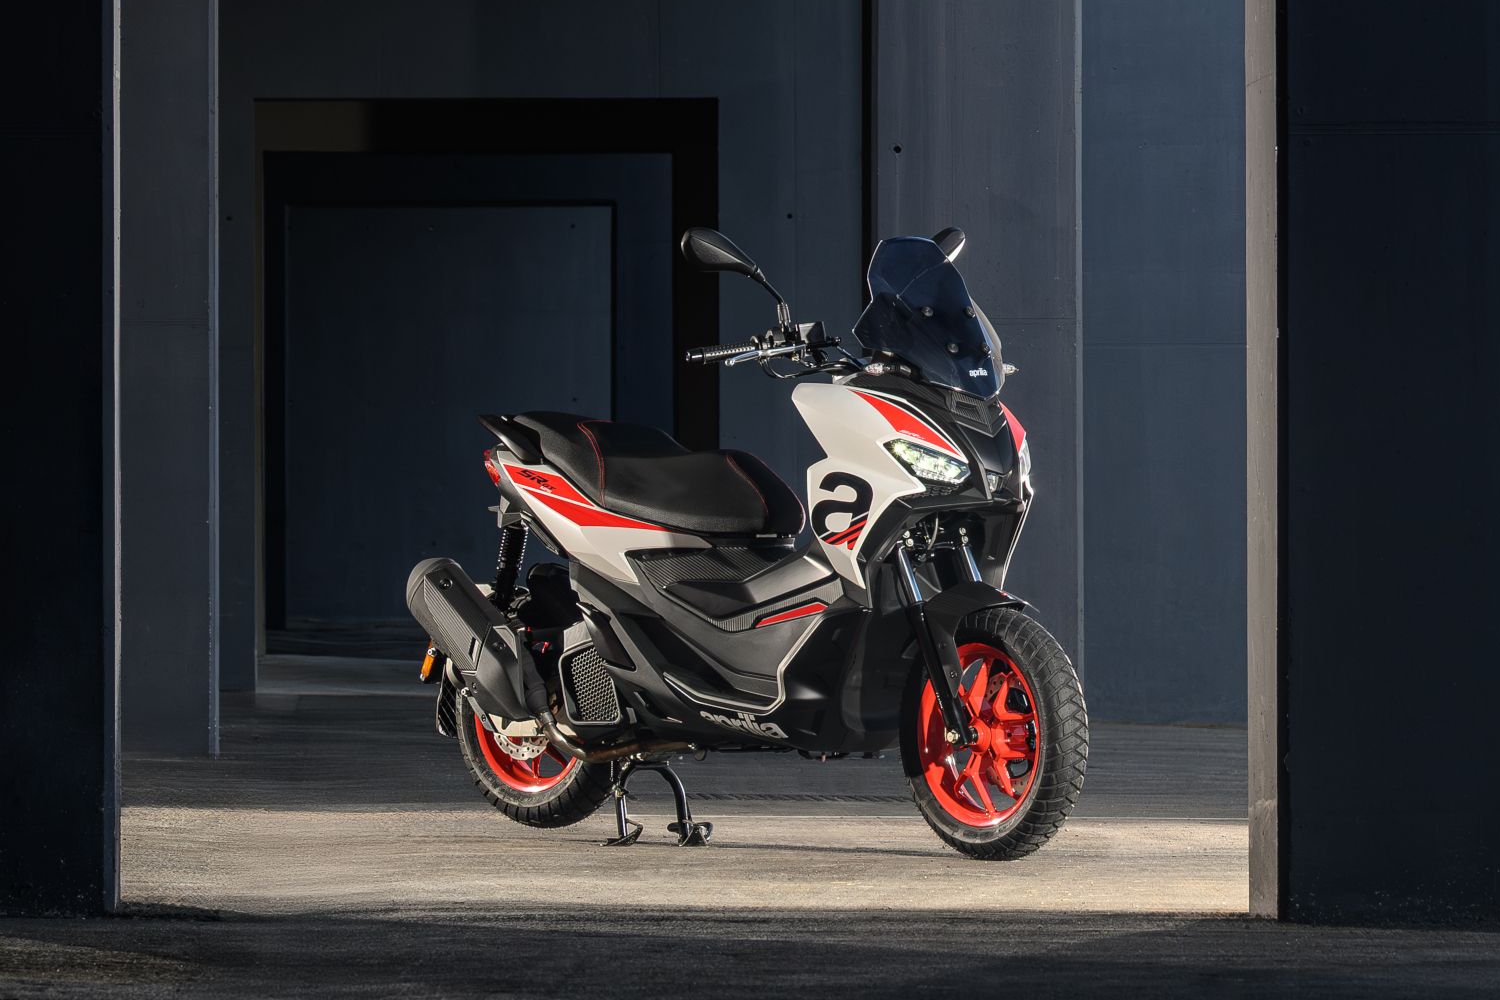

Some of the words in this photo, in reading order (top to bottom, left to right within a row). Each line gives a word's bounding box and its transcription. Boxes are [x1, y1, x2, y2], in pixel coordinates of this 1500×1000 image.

[969, 367, 988, 378] aprilia
[516, 469, 549, 485] SR
[811, 471, 873, 550] a
[700, 709, 788, 738] aprilia
